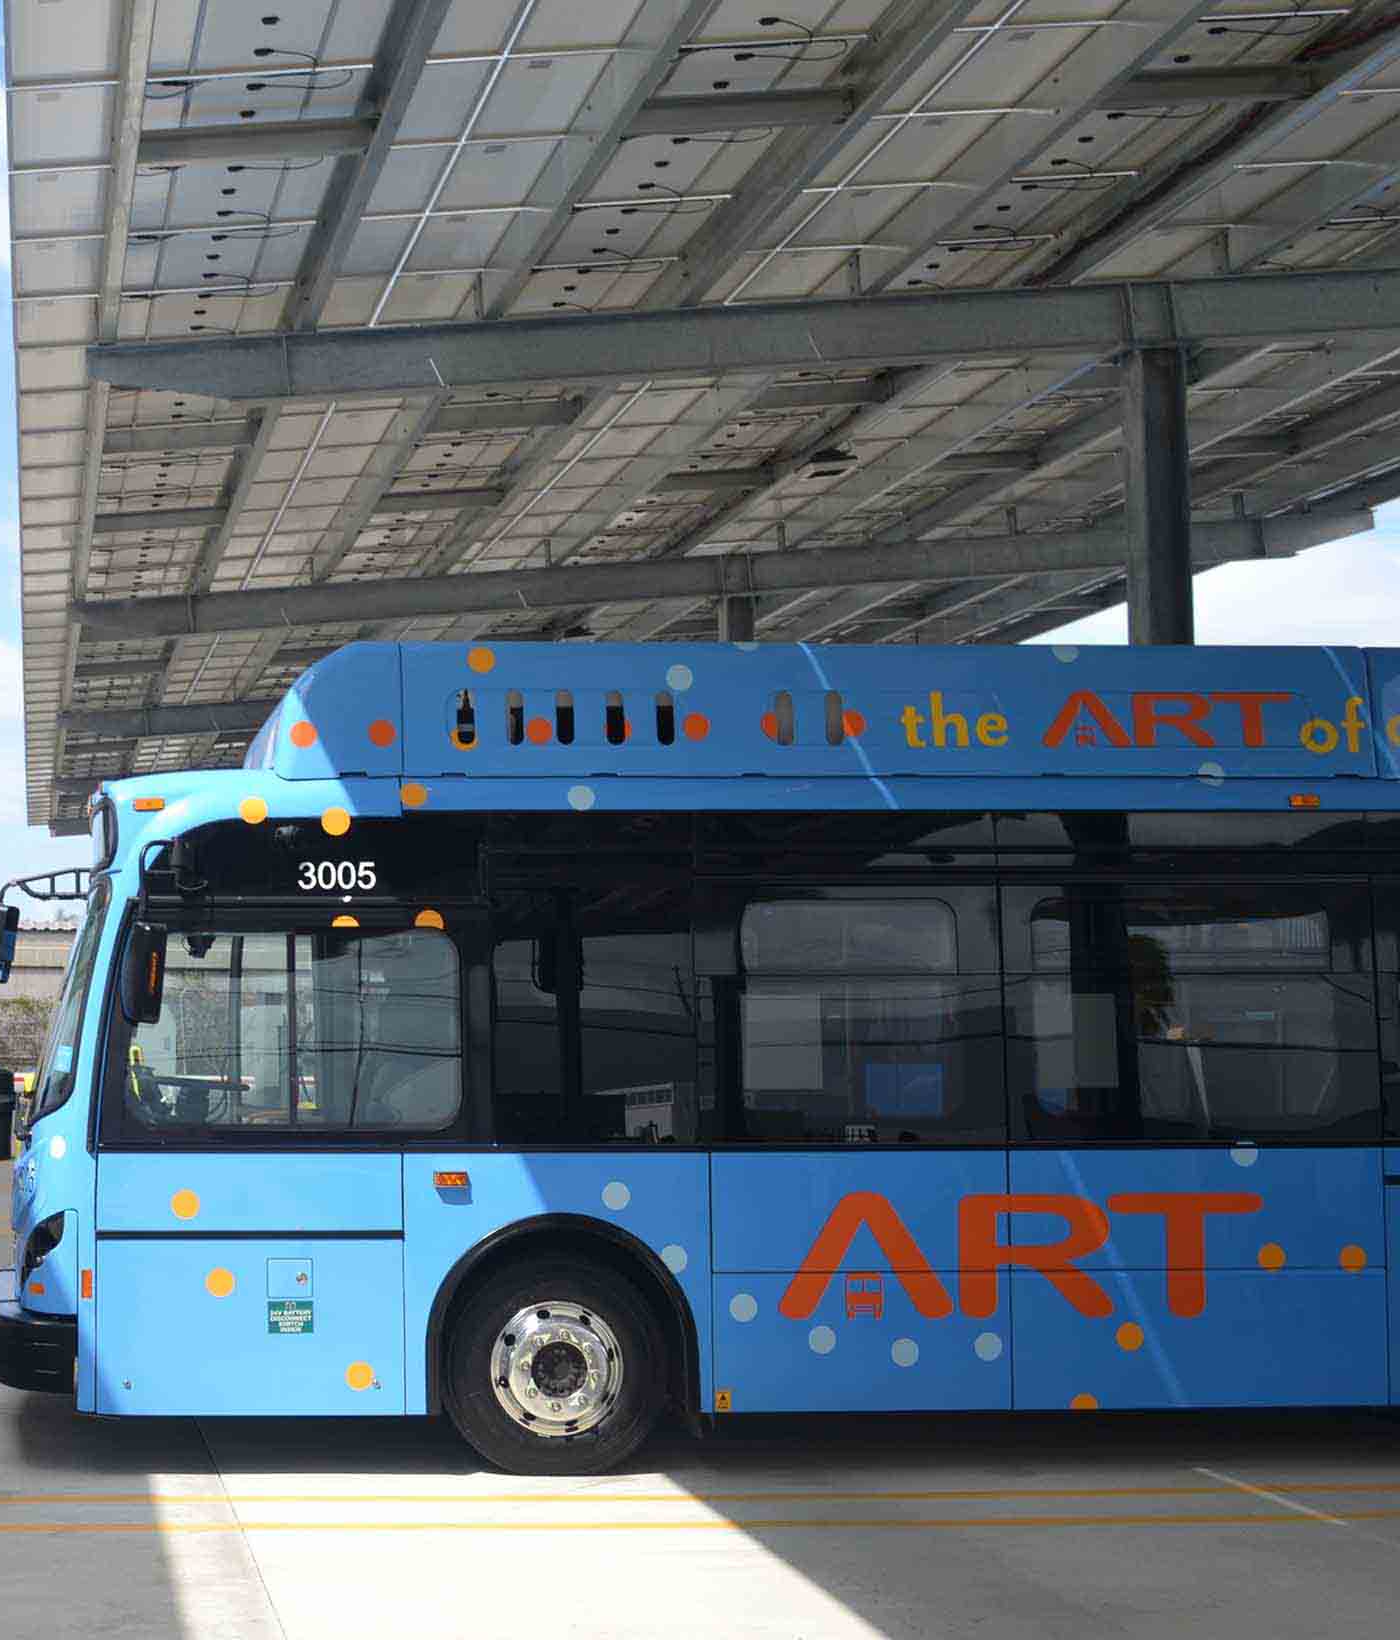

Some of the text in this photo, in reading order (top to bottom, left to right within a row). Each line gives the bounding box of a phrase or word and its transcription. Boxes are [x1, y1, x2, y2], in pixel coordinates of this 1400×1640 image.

[899, 690, 1009, 748] the
[1041, 688, 1293, 748] ART
[1299, 696, 1367, 754] of
[297, 860, 377, 890] 3005
[777, 1190, 1264, 1320] ART
